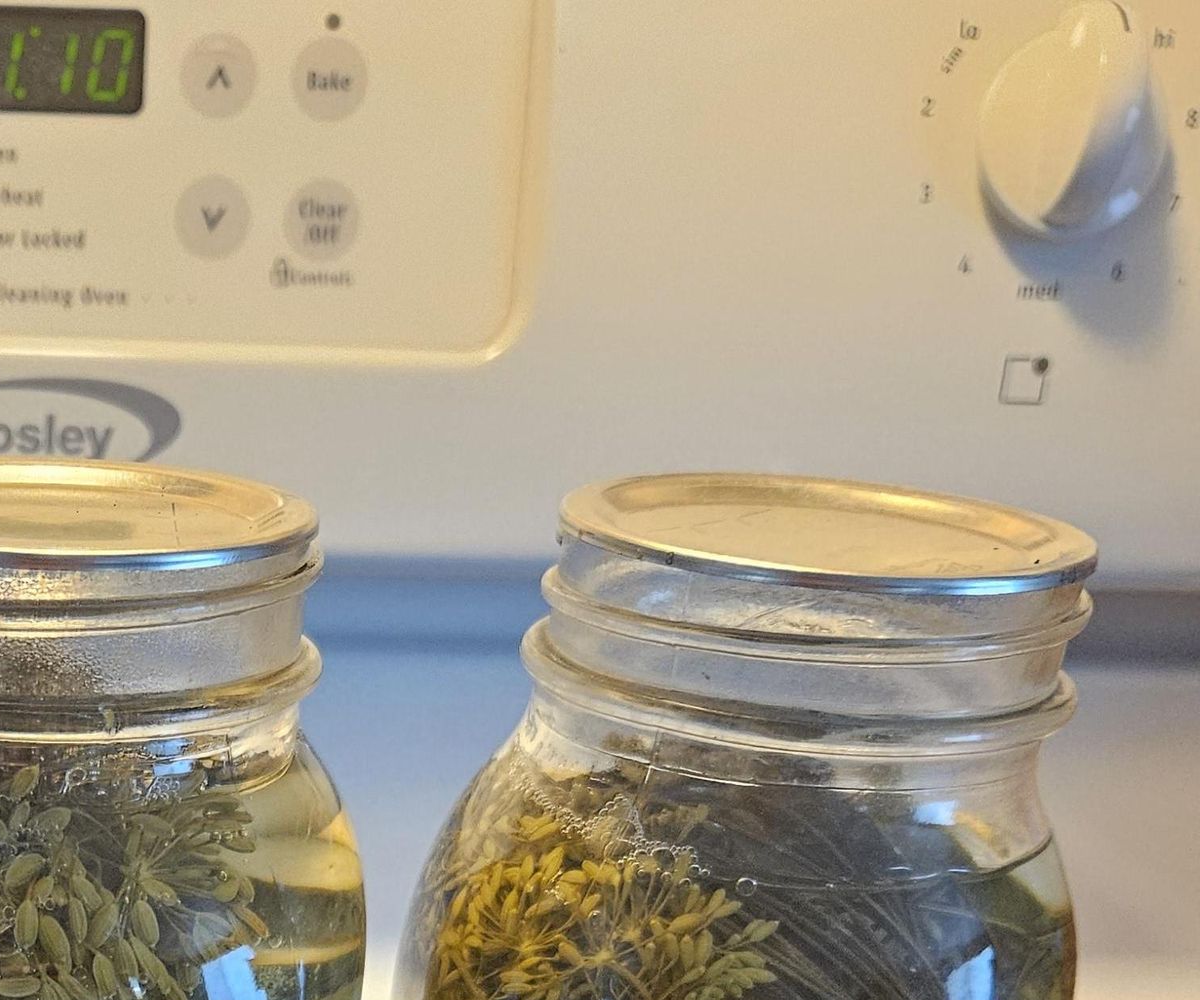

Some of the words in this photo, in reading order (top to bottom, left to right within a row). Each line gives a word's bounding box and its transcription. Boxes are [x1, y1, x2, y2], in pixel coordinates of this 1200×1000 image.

[306, 70, 352, 93] Bake
[920, 97, 934, 117] 2
[298, 198, 347, 220] Clear
[21, 229, 86, 249] Locked
[958, 255, 973, 274] 4
